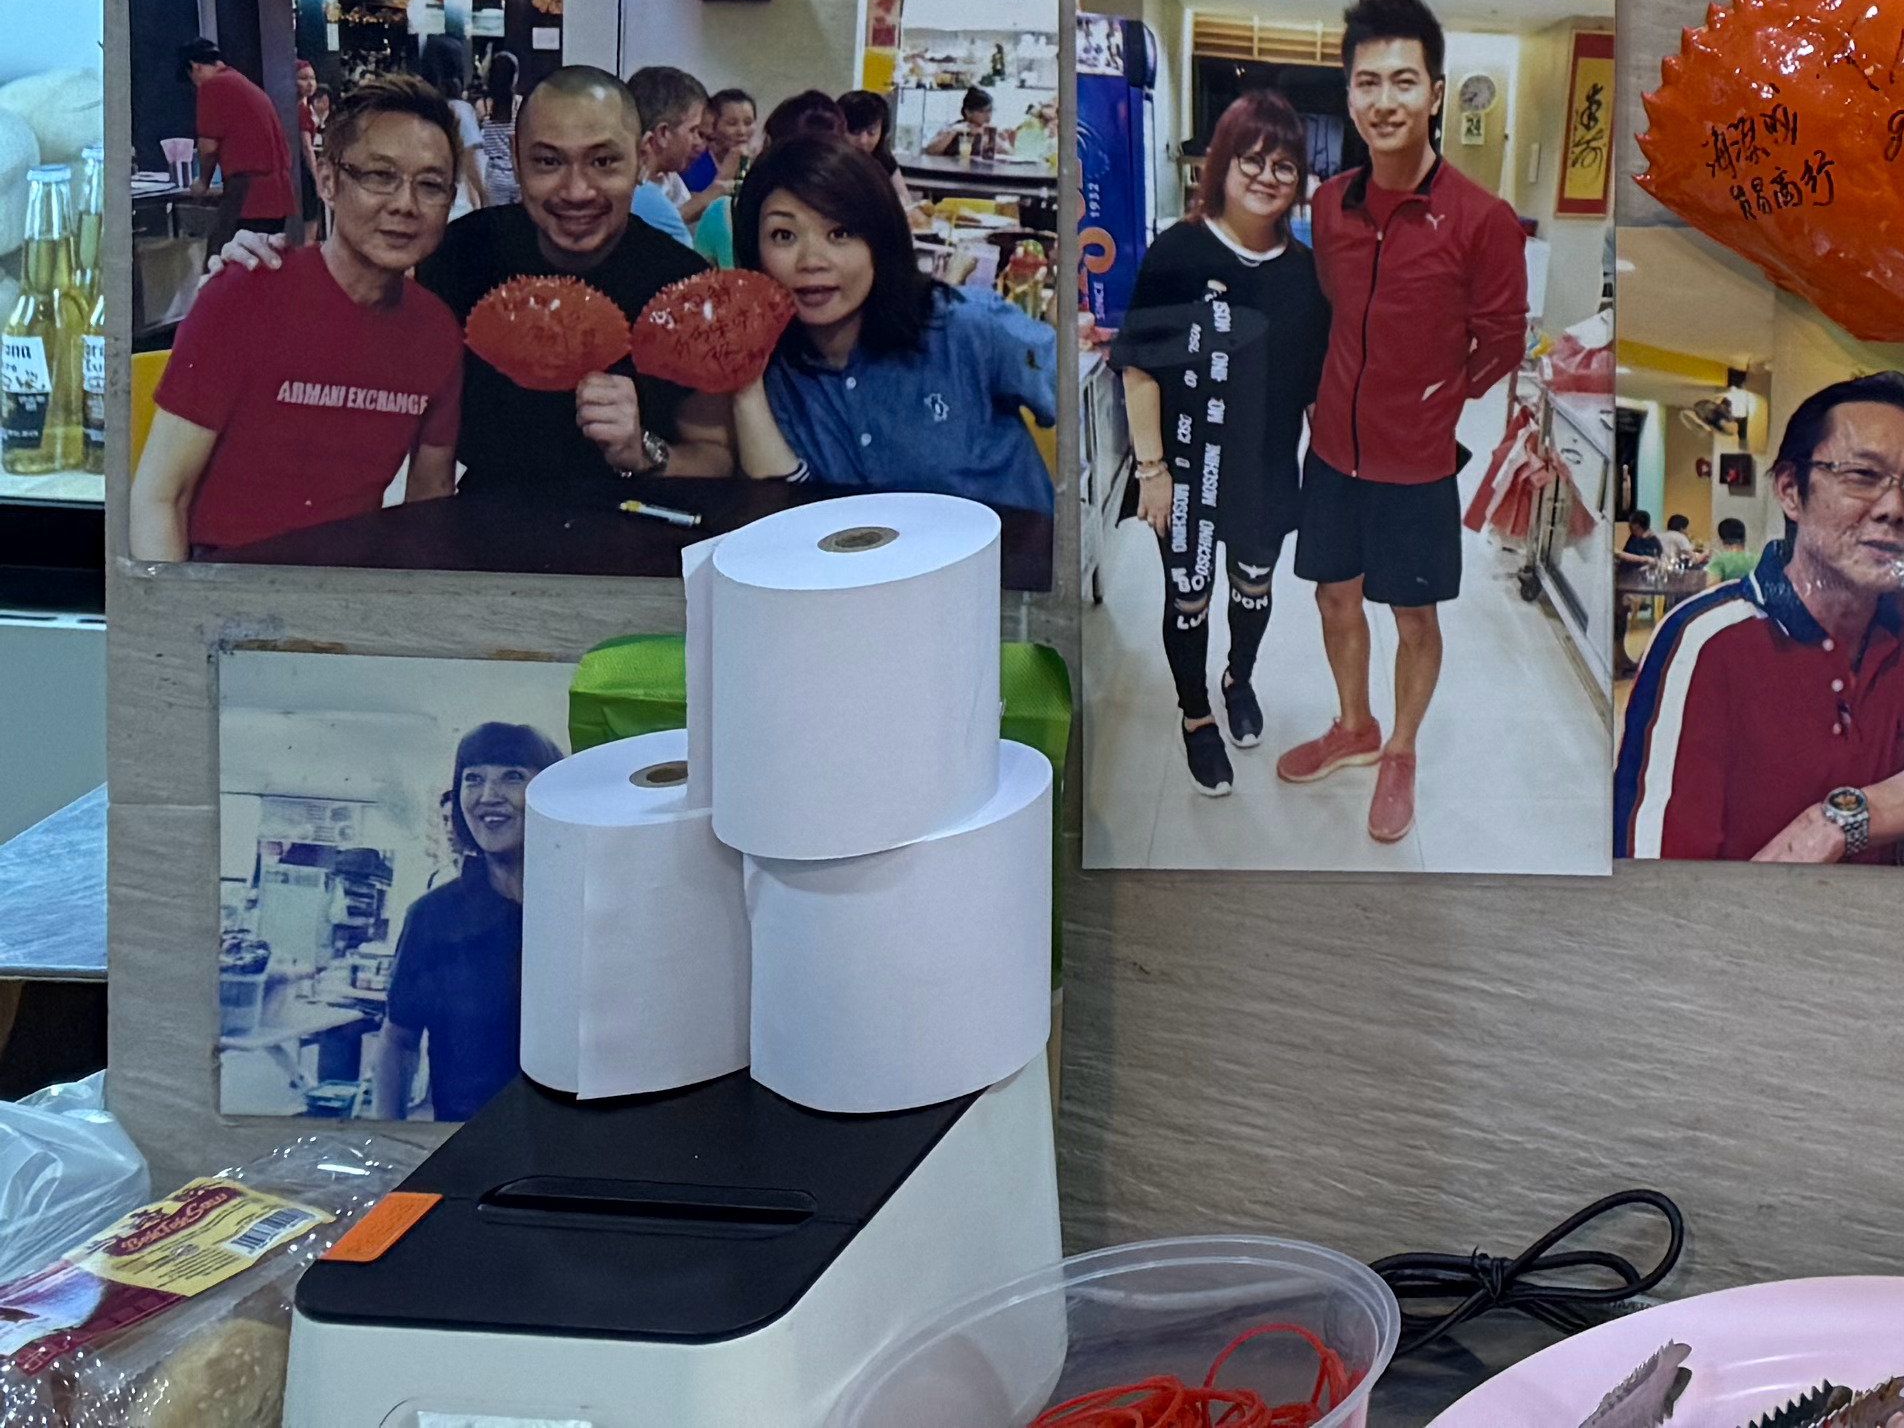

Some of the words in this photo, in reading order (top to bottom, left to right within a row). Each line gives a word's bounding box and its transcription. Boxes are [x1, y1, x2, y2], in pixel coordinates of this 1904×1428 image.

[1089, 182, 1102, 218] 1932
[277, 380, 347, 407] ARMANI
[347, 386, 429, 417] EXCHANGE
